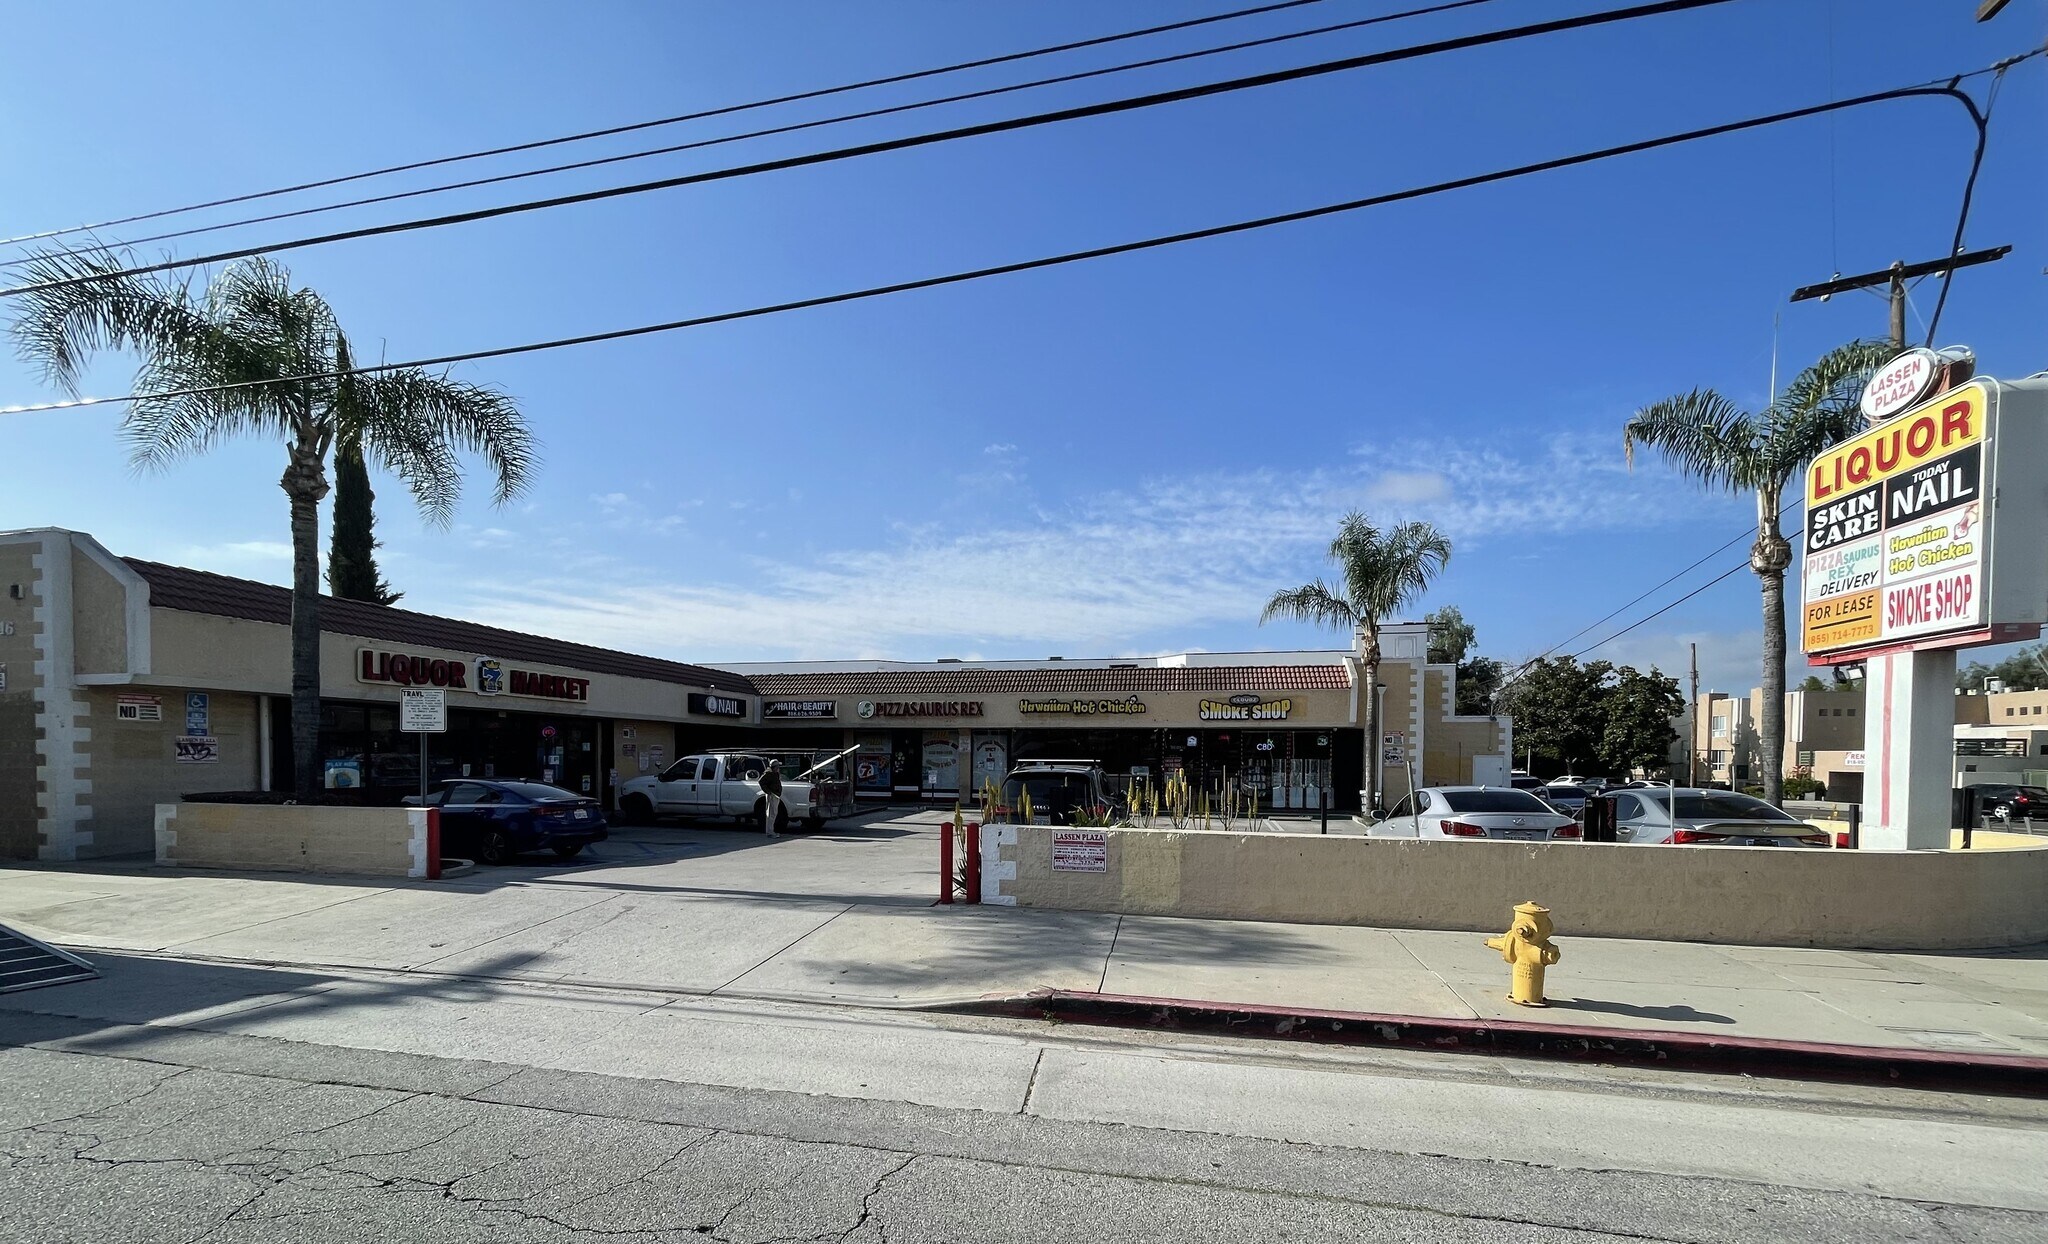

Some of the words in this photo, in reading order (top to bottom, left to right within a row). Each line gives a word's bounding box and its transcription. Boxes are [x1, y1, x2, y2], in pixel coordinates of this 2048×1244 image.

[1871, 358, 1922, 397] LASSEN
[1875, 383, 1916, 411] PLAZA
[1814, 400, 1973, 500] LIQUOR
[1912, 460, 1950, 484] TODAY
[1892, 467, 1974, 520] NAIL
[1813, 489, 1877, 530] SKIN
[1810, 510, 1879, 550] CARE
[1890, 525, 1949, 554] Hawaiian
[1828, 563, 1856, 581] REX
[1889, 557, 1915, 576] Hot
[1918, 541, 1974, 568] Chicken
[1820, 570, 1879, 597] DELIVERY
[1808, 605, 1831, 622] FOR
[1835, 595, 1874, 616] LEASE
[1888, 583, 1932, 629] SMOKE
[1935, 574, 1973, 620] SHOP
[1807, 632, 1829, 646] (855)
[1832, 624, 1874, 641] 714-7773
[362, 650, 468, 688] LIQUOR
[510, 670, 590, 700] MARKET
[119, 706, 137, 719] NO
[718, 699, 740, 715] NAIL
[777, 702, 798, 711] HAIR
[802, 702, 833, 711] BEAUTY
[875, 701, 958, 717] PIZZASAURUS
[961, 701, 984, 716] REX
[1019, 700, 1070, 714] Hawaiian
[1073, 701, 1096, 714] Hot
[1099, 700, 1146, 714] Chicken
[1200, 700, 1249, 720] SMOKE
[1251, 699, 1292, 719] SHOP
[1256, 743, 1273, 751] CBD
[1056, 833, 1080, 841] LASSEN
[1082, 834, 1104, 842] PLAZA
